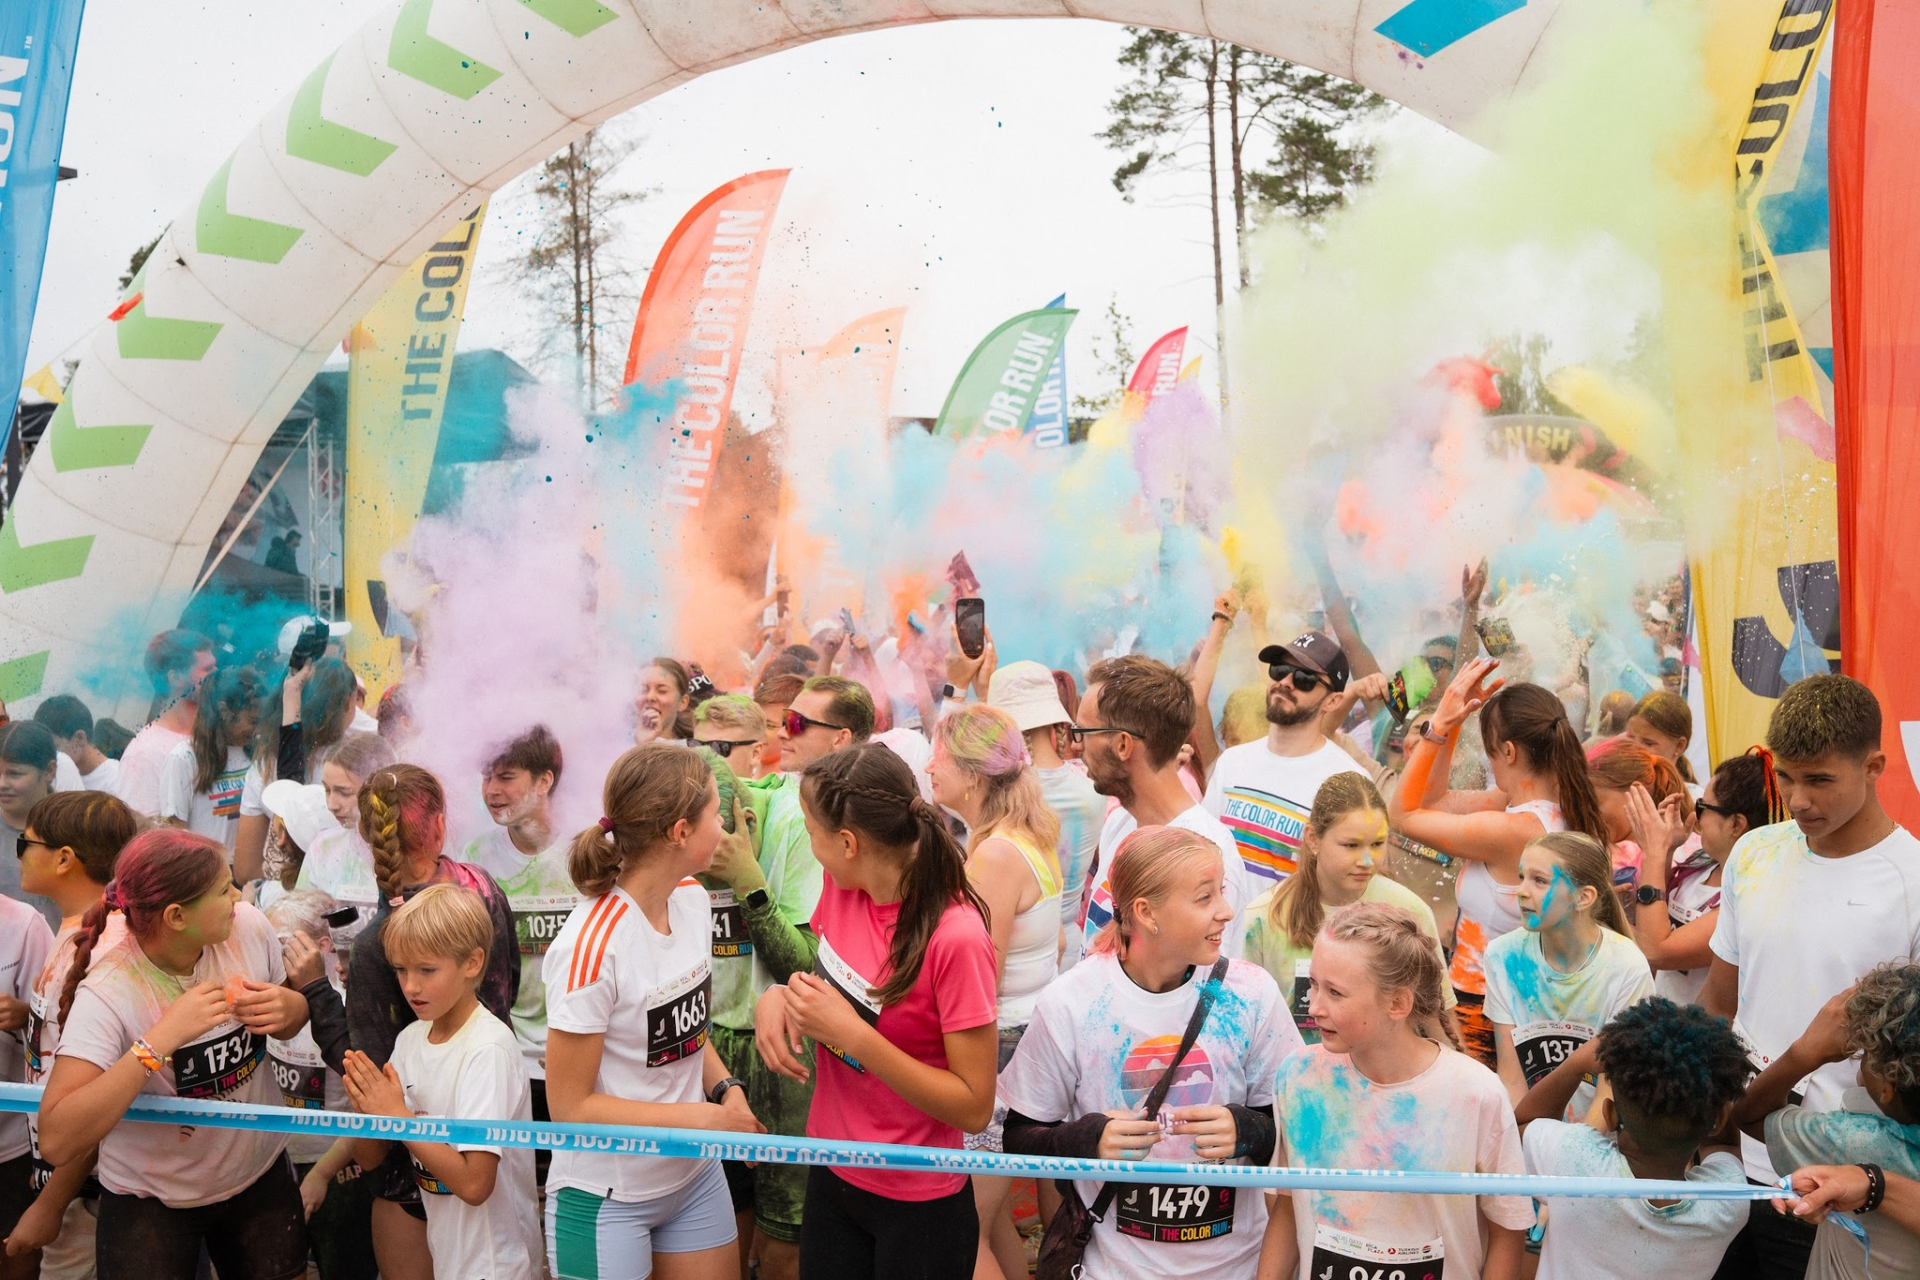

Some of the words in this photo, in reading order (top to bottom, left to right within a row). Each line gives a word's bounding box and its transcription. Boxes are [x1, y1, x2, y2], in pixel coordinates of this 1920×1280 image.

[414, 204, 482, 323] COL
[702, 209, 766, 290] RUN
[401, 333, 447, 424] THE
[675, 297, 738, 432] COLOR
[999, 330, 1055, 393] RUN
[1151, 352, 1181, 397] RUN
[1491, 425, 1573, 452] INISH
[1224, 798, 1244, 818] THE
[1241, 802, 1278, 829] COLOR
[1275, 814, 1305, 840] RUN
[713, 944, 739, 955] COLOR
[671, 989, 707, 1037] 1663
[204, 1028, 254, 1075] 1732
[221, 1073, 237, 1089] THE
[236, 1057, 257, 1081] COLOR
[1539, 1039, 1585, 1064] 137
[336, 1164, 363, 1185] GAP
[1148, 1185, 1211, 1219] 1479
[1161, 1226, 1180, 1241] THE
[1180, 1225, 1211, 1241] COLOR
[1211, 1220, 1229, 1237] RUN
